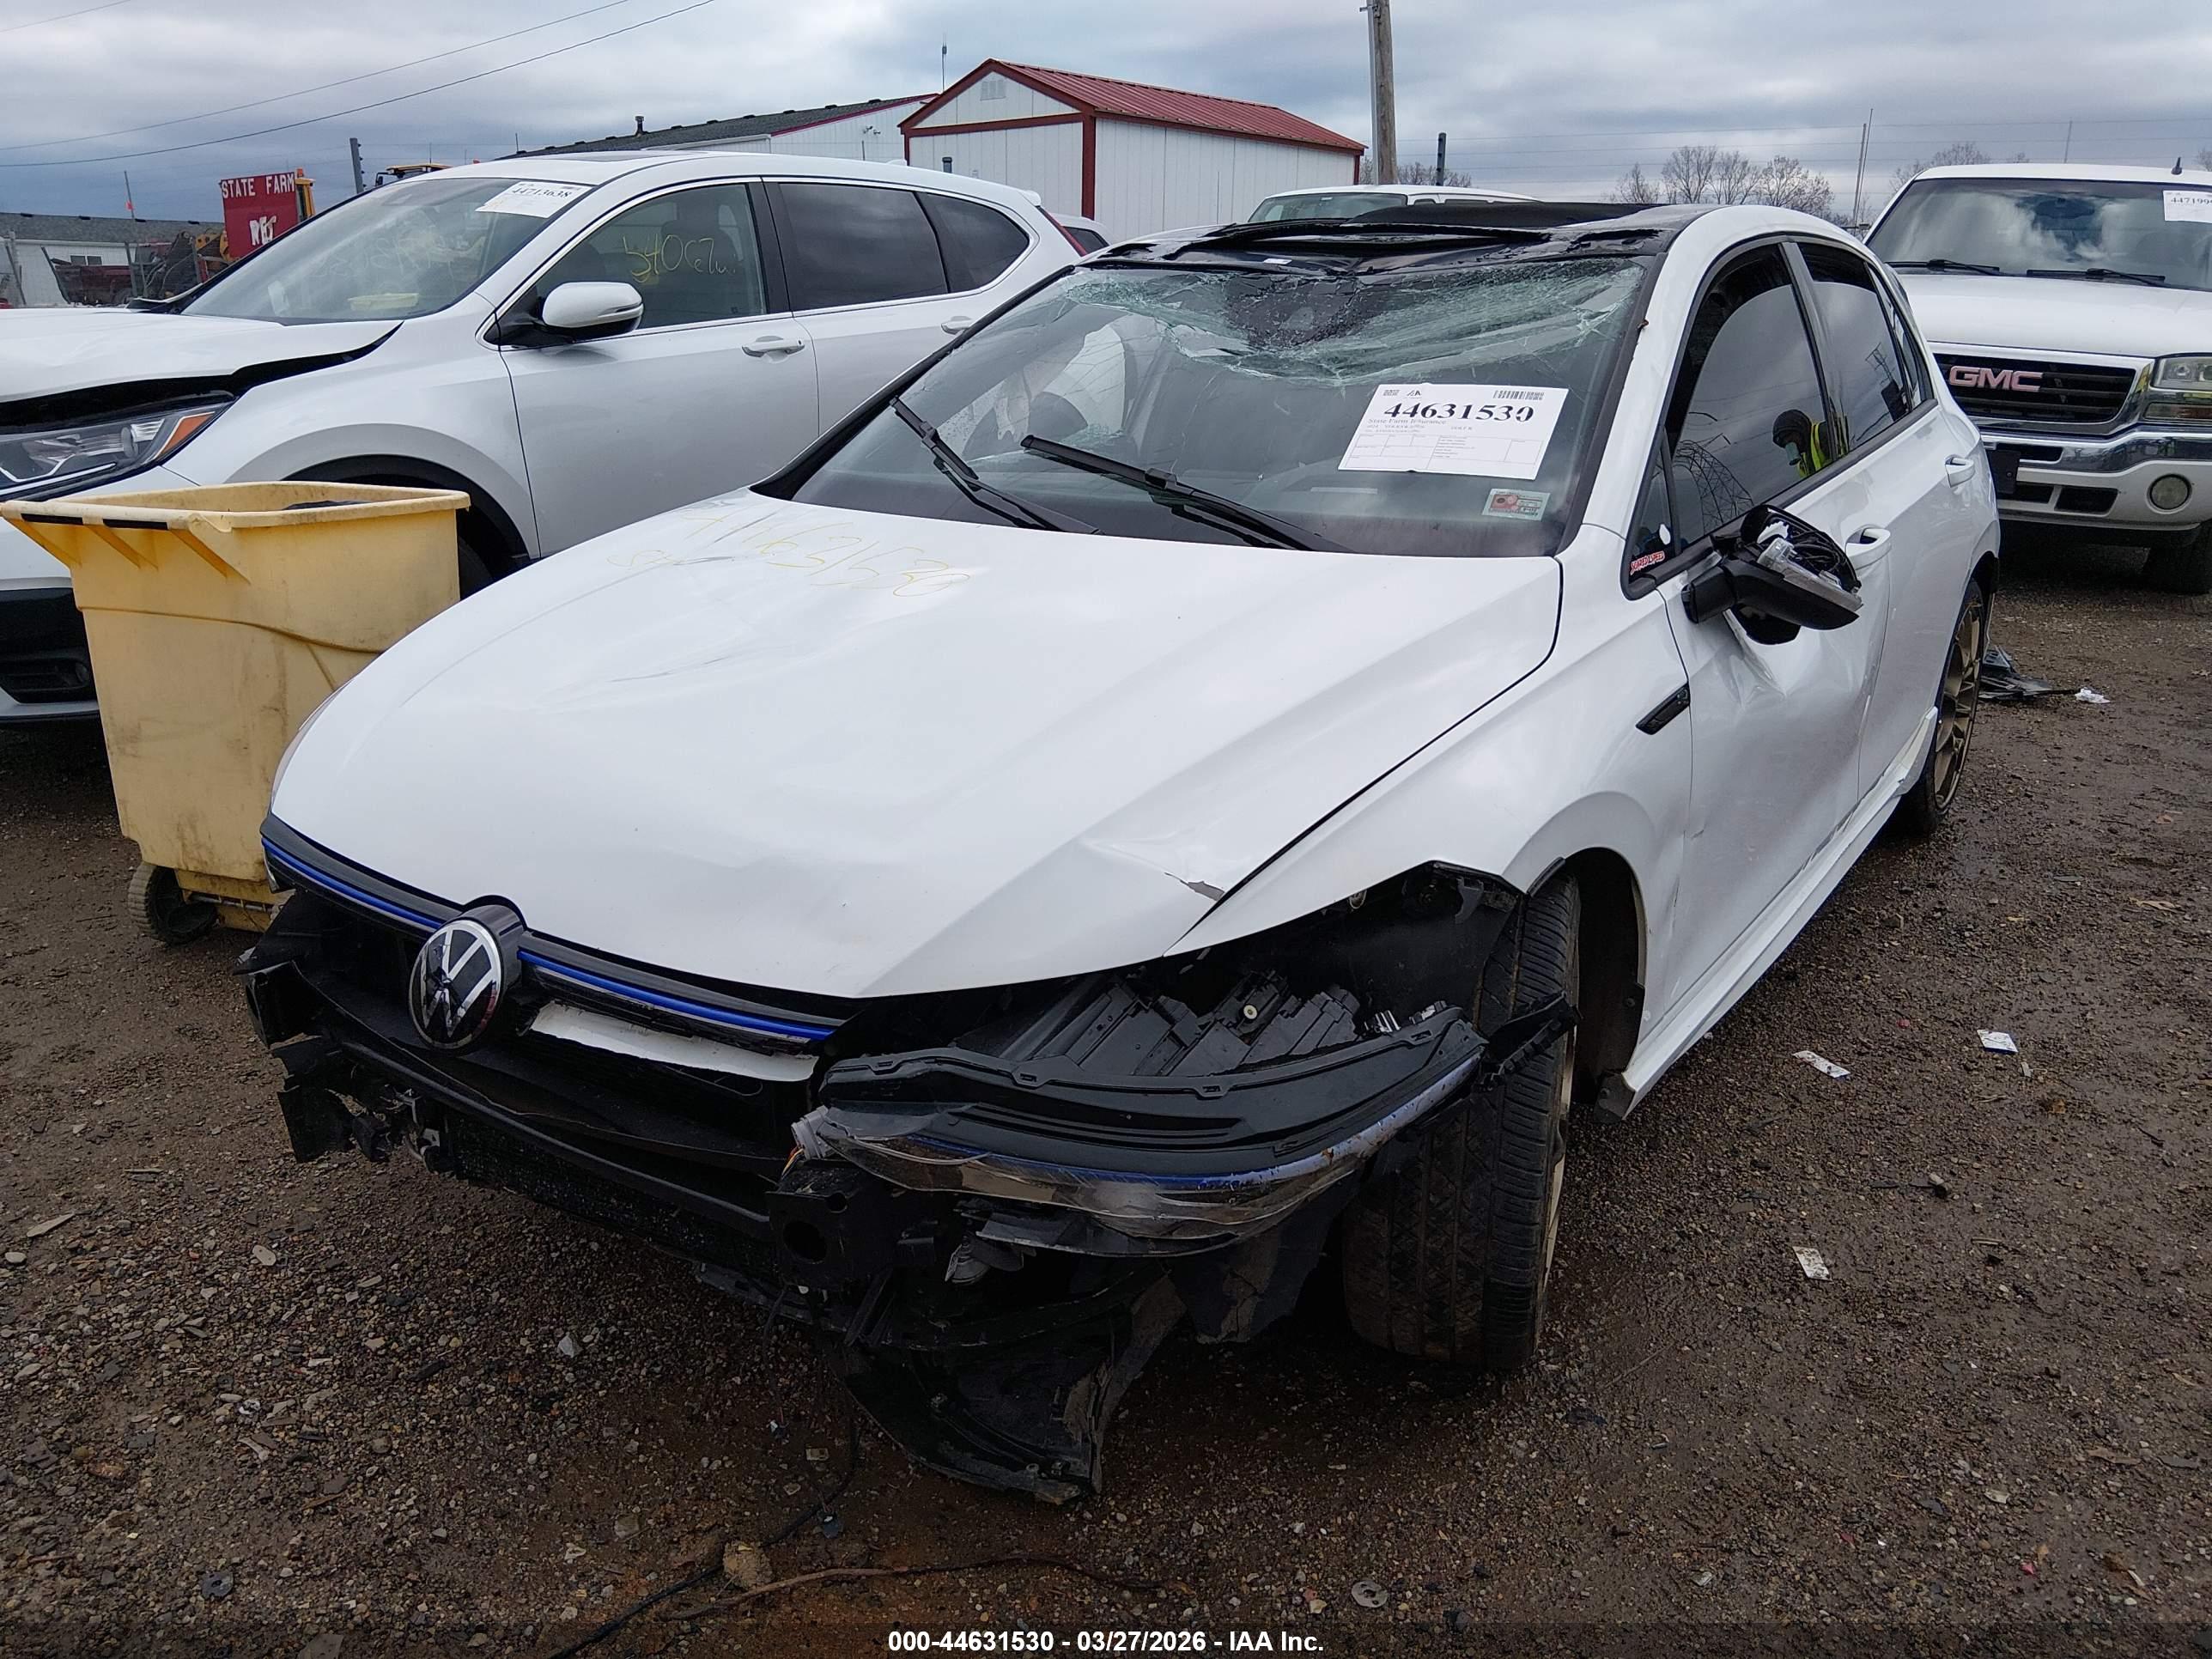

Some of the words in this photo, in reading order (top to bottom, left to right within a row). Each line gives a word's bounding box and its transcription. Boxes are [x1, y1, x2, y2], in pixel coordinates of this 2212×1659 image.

[222, 179, 256, 198] STATE
[266, 173, 295, 194] FARM
[1949, 365, 2043, 392] GMC
[1383, 403, 1534, 422] 44631530
